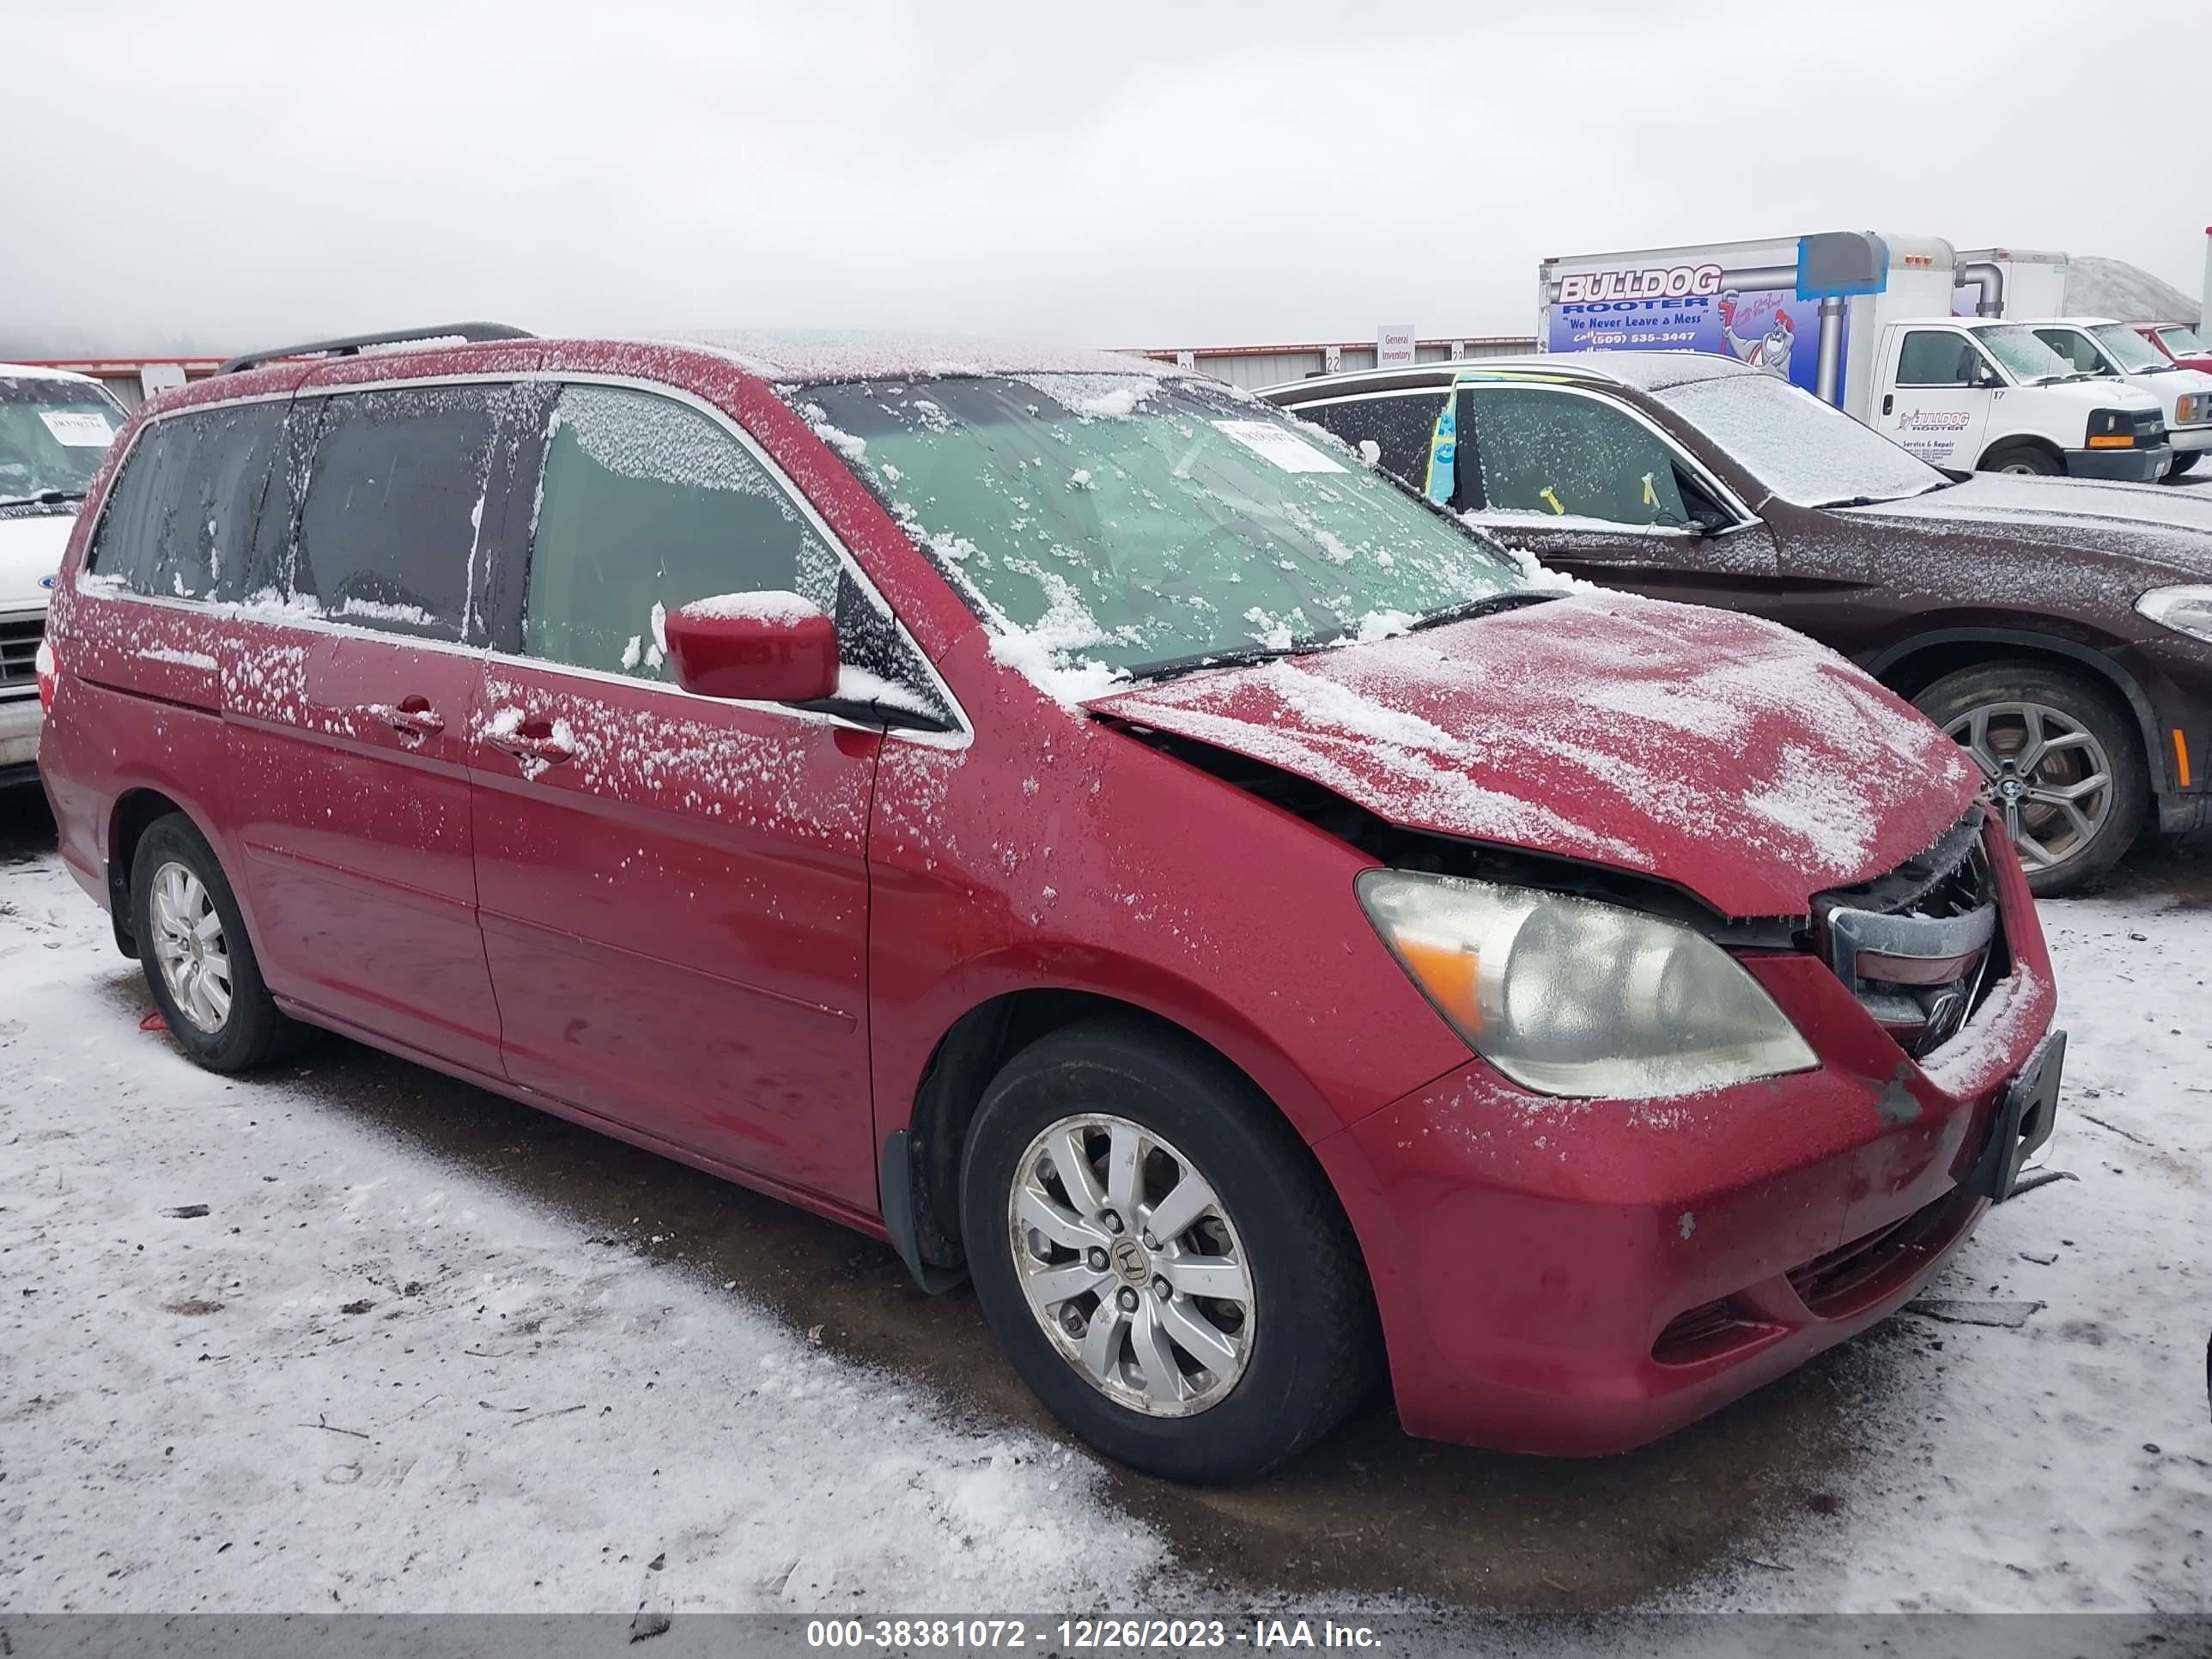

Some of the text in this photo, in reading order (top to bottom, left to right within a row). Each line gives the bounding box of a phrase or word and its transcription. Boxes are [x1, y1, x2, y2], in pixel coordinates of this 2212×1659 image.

[1559, 264, 1723, 304] BULLDOG
[1563, 298, 1709, 314] ROOTER
[1589, 317, 1621, 328] Never
[1626, 315, 1658, 327] Leave
[1385, 334, 1409, 344] General
[1592, 334, 1627, 344] (509)
[1632, 332, 1696, 343] 535-3447
[1382, 349, 1411, 362] Inventory
[1327, 356, 1340, 373] 22
[1994, 391, 2006, 399] 17
[1911, 412, 1971, 427] BULLDOG
